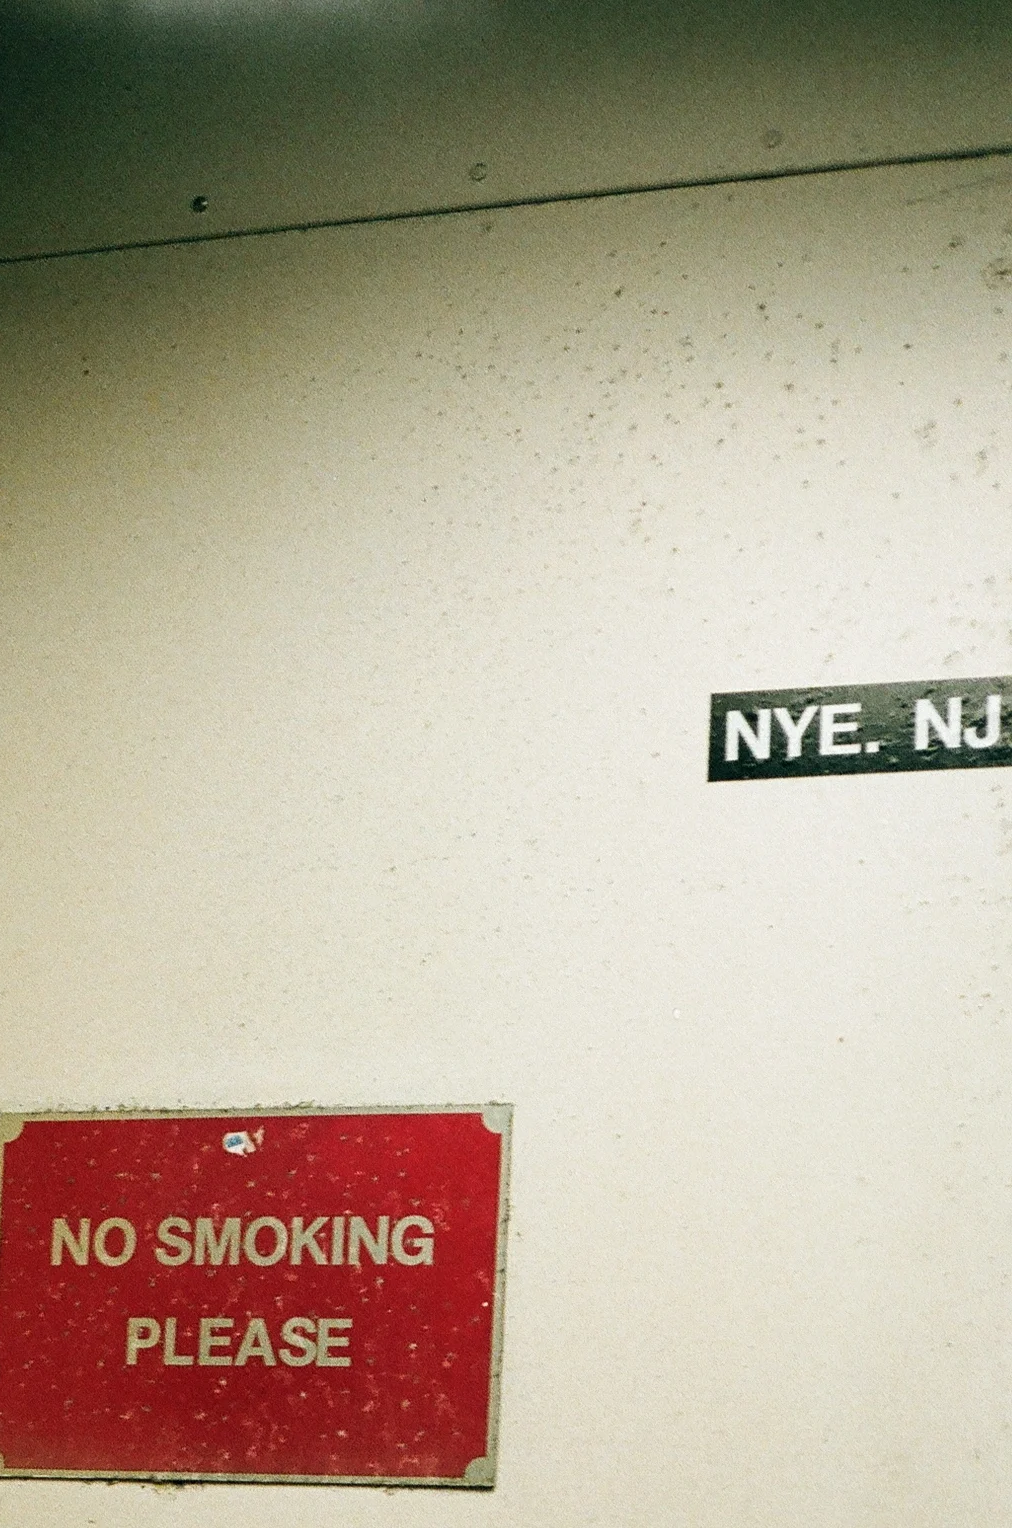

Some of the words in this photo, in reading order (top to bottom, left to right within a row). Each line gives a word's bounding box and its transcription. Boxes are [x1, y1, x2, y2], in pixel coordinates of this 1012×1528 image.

[724, 702, 880, 762] NYE.
[913, 694, 1002, 751] NJ
[50, 1217, 137, 1266] NO
[154, 1214, 435, 1267] SMOKING
[125, 1317, 354, 1368] PLEASE
